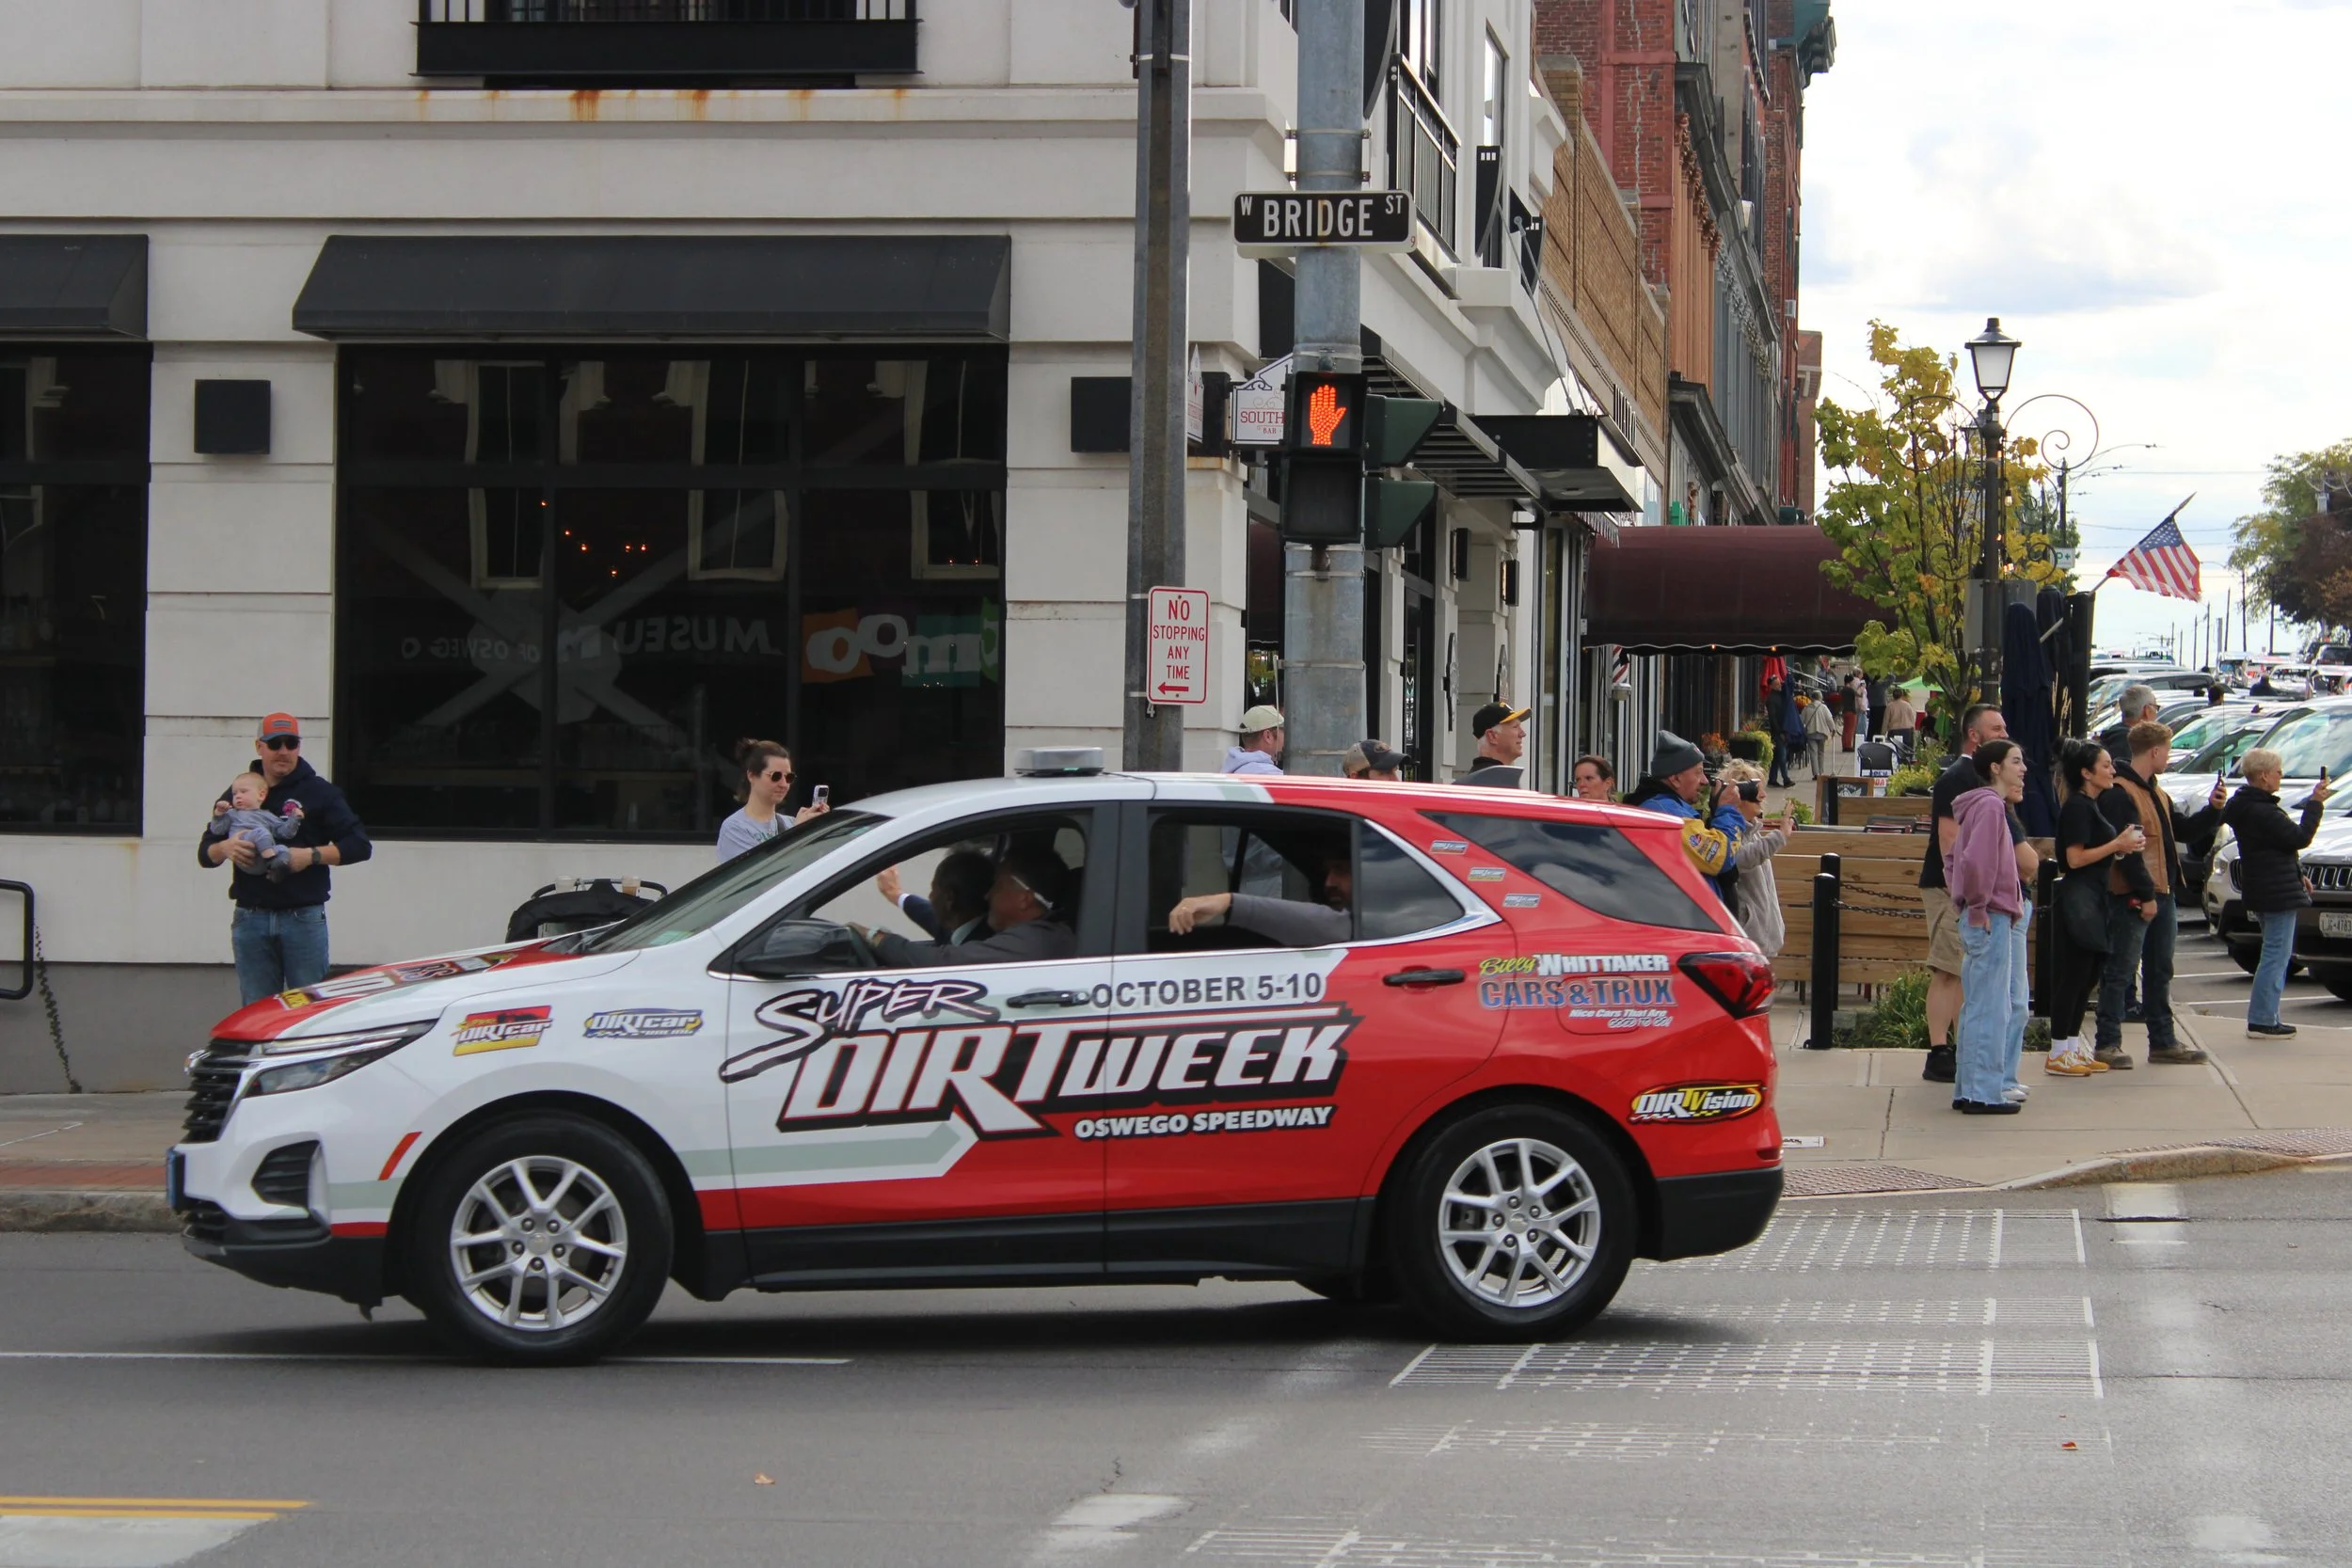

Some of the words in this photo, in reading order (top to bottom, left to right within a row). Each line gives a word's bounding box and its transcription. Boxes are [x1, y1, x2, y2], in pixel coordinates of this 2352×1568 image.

[1240, 196, 1253, 216] W
[1263, 198, 1374, 237] BRIDGE
[1385, 194, 1404, 214] ST
[1168, 599, 1190, 621] NO
[1152, 625, 1205, 641] STOPPING
[1167, 645, 1189, 660] ANY
[1167, 664, 1190, 680] TIME
[1478, 957, 1536, 977] Billy
[1534, 954, 1670, 976] WHITTAKER
[1091, 975, 1246, 1008] OCTOBER
[1256, 973, 1322, 1001] 5-10
[1074, 1114, 1188, 1138] OSWEGO
[1192, 1106, 1333, 1132] SPEEDWAY
